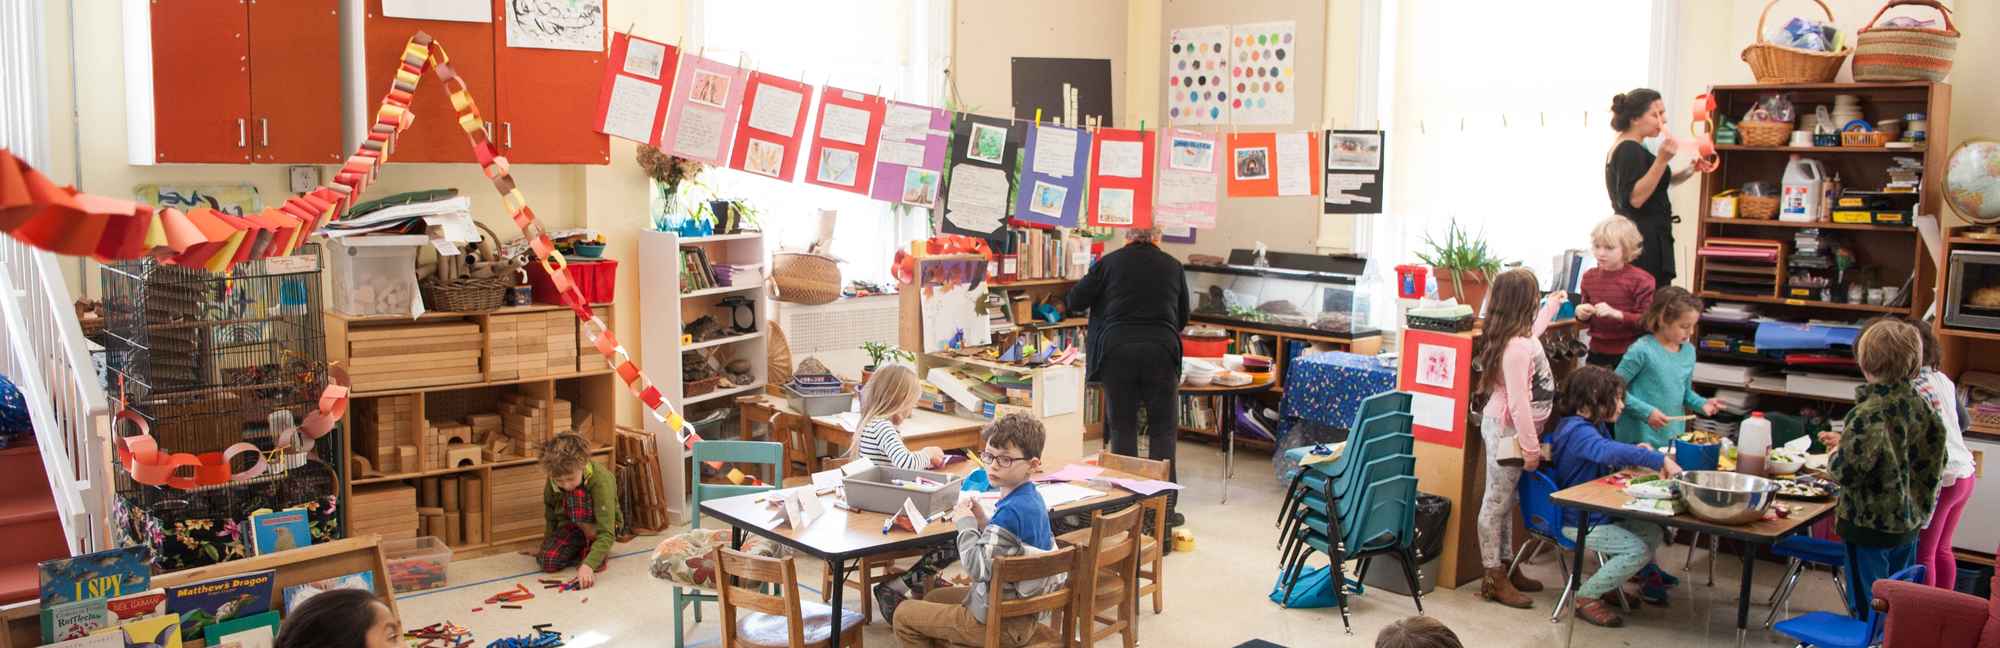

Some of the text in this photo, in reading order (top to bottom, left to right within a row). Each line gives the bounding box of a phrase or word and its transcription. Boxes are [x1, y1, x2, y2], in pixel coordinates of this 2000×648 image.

[75, 574, 122, 602] I SPY
[232, 576, 268, 588] Dragon
